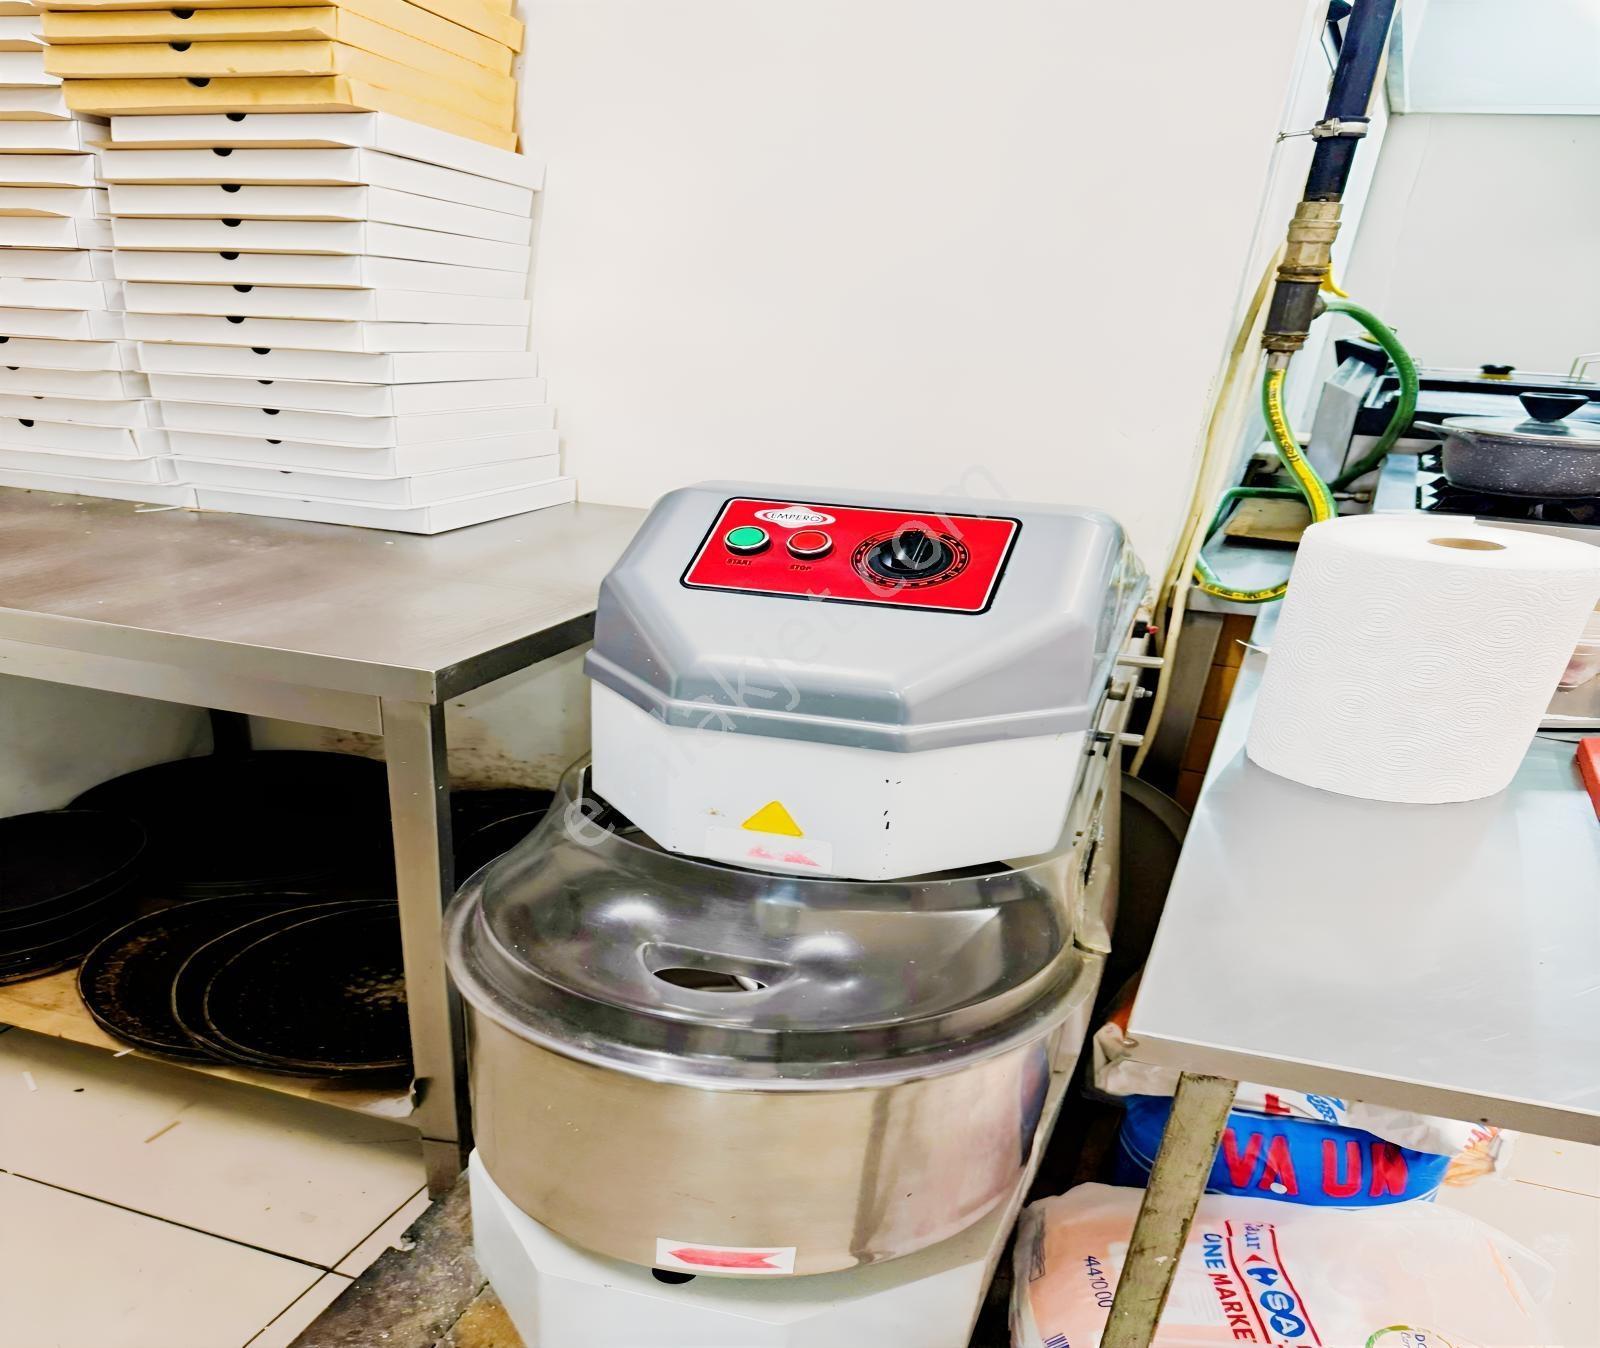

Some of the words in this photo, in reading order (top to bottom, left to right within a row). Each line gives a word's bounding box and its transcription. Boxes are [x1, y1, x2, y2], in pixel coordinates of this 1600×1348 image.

[769, 511, 821, 523] EMPERO
[726, 558, 752, 567] START
[789, 564, 813, 572] STOP
[1203, 1233, 1226, 1269] ONE
[1208, 1273, 1256, 1344] MARKE
